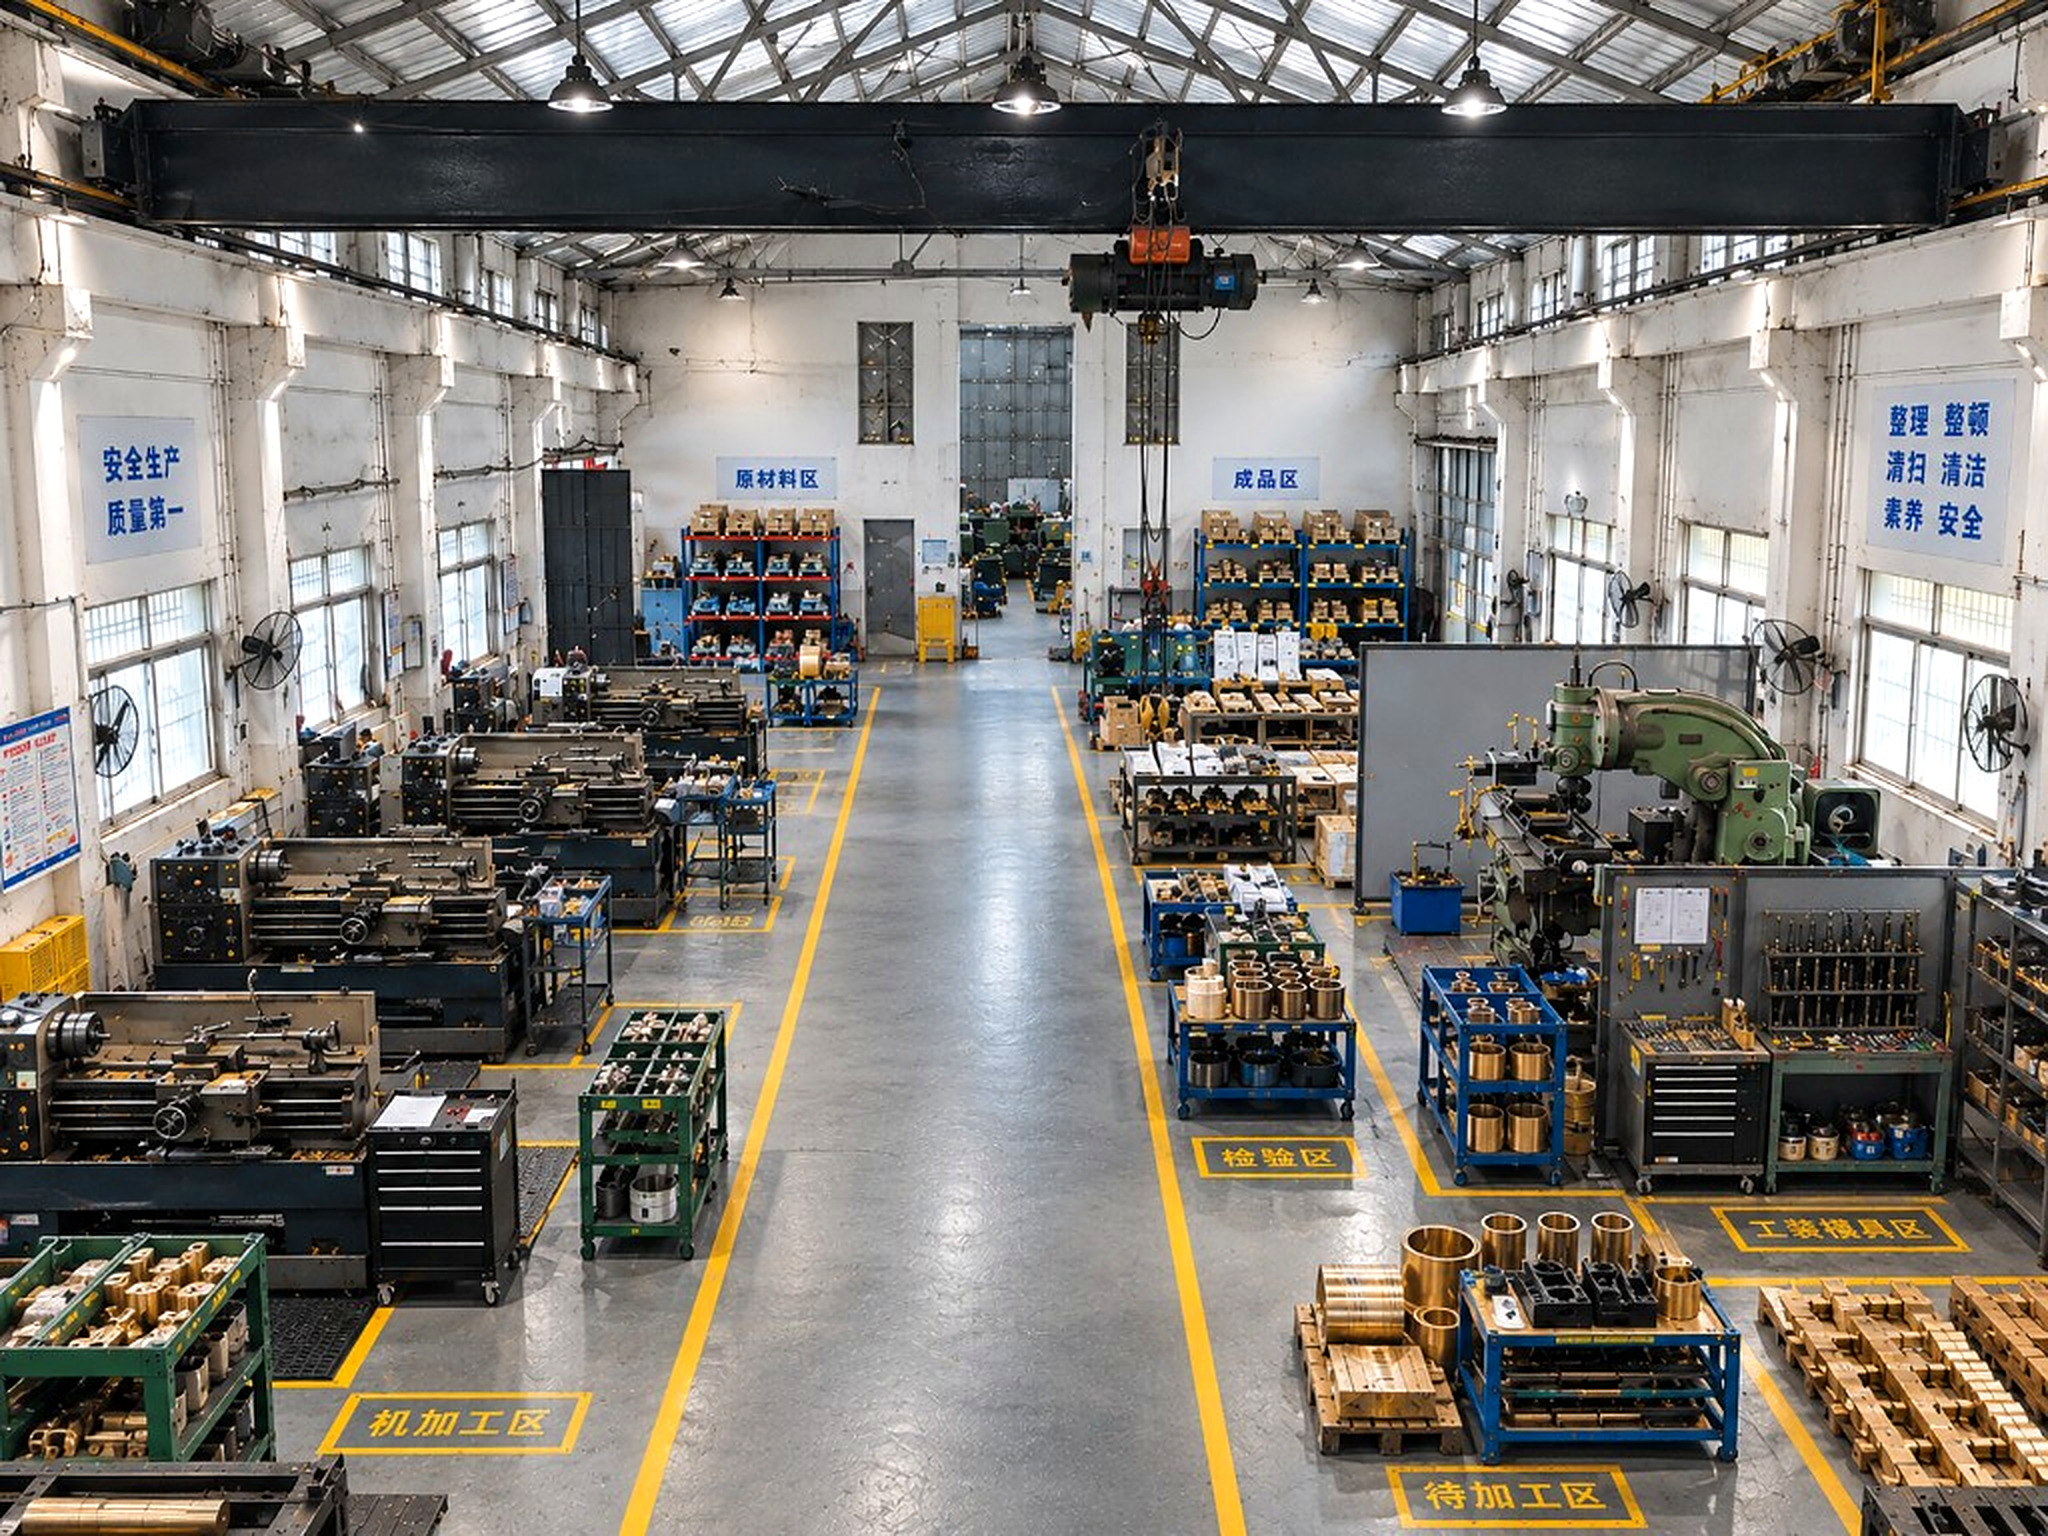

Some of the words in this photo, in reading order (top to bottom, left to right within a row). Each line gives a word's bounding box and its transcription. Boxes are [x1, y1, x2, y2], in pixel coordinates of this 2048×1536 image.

[1889, 404, 1929, 437] 整理
[1944, 402, 1990, 437] 整顿
[103, 445, 180, 483] 安全生产
[735, 469, 819, 489] 原材料区
[1233, 468, 1298, 489] 成品区
[1886, 450, 1927, 485] 清扫
[1941, 451, 1987, 488] 清洁
[107, 495, 184, 537] 质量第一
[1884, 496, 1924, 532] 素养
[1938, 502, 1983, 540] 安全
[1221, 1147, 1337, 1168] 检验区
[368, 1408, 551, 1438] 机加工区
[1423, 1480, 1607, 1511] 待加工区
